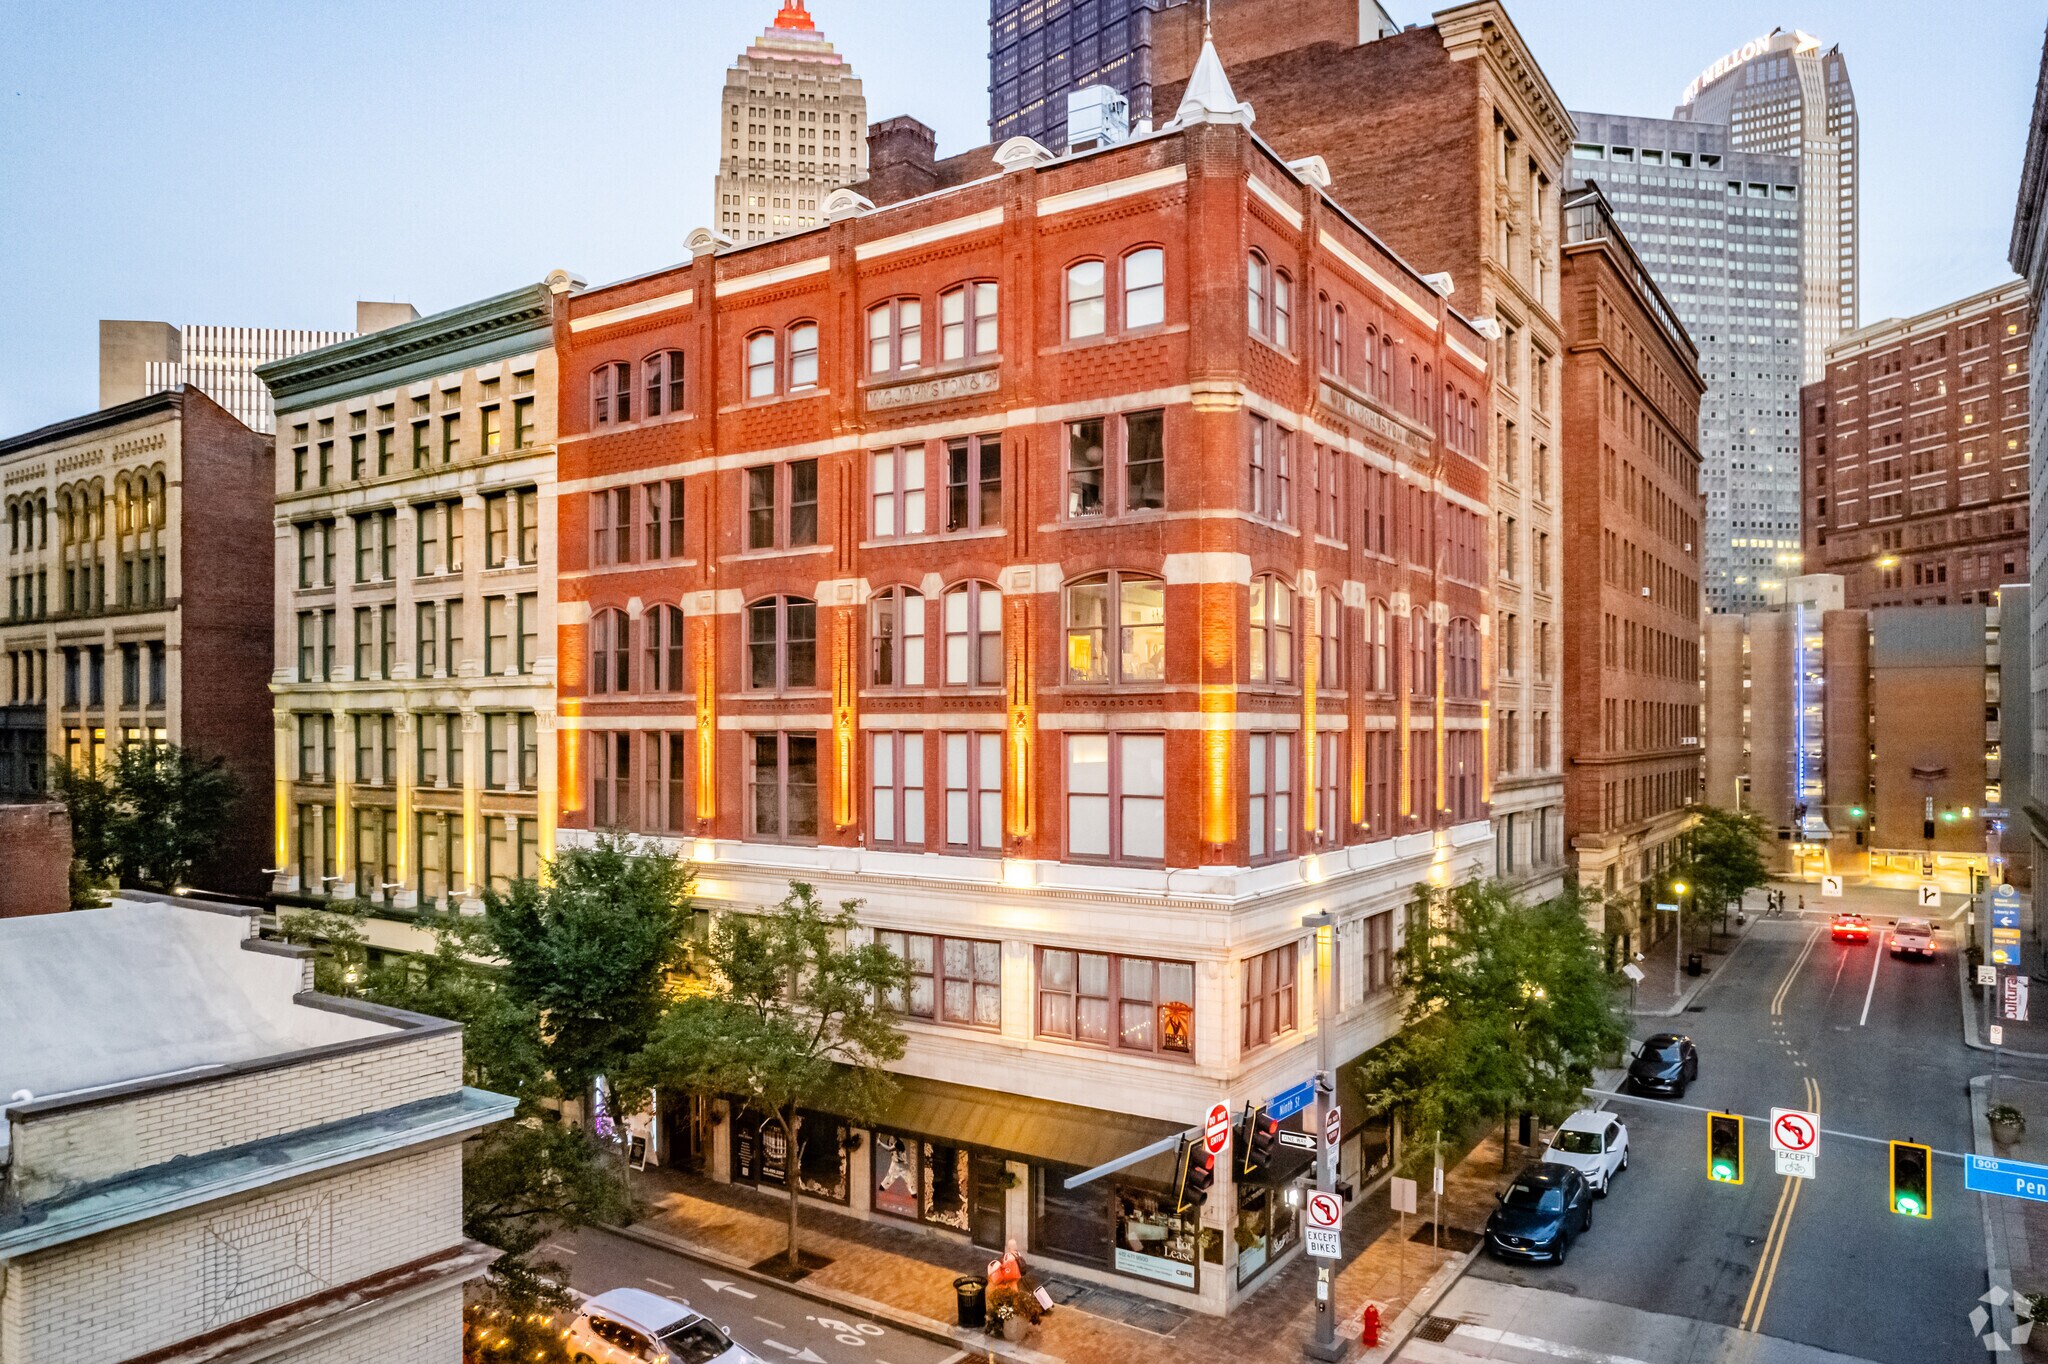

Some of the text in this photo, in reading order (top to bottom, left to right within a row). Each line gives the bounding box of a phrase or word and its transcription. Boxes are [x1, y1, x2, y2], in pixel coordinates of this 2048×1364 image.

[1701, 33, 1770, 87] MELLON
[1980, 975, 1994, 983] 25
[1280, 1095, 1300, 1115] Ninth St
[1209, 1110, 1226, 1126] DO NOT
[1210, 1132, 1224, 1146] ENTER
[1283, 1135, 1294, 1143] ONE
[1779, 1151, 1811, 1162] EXCEPT
[1977, 1160, 1999, 1170] 900
[2016, 1178, 2047, 1196] Pen
[1308, 1231, 1337, 1243] EXCEPT
[1176, 1237, 1193, 1250] For
[1311, 1241, 1337, 1253] BIKES
[1164, 1246, 1193, 1262] Lease
[1175, 1269, 1193, 1279] CBRE
